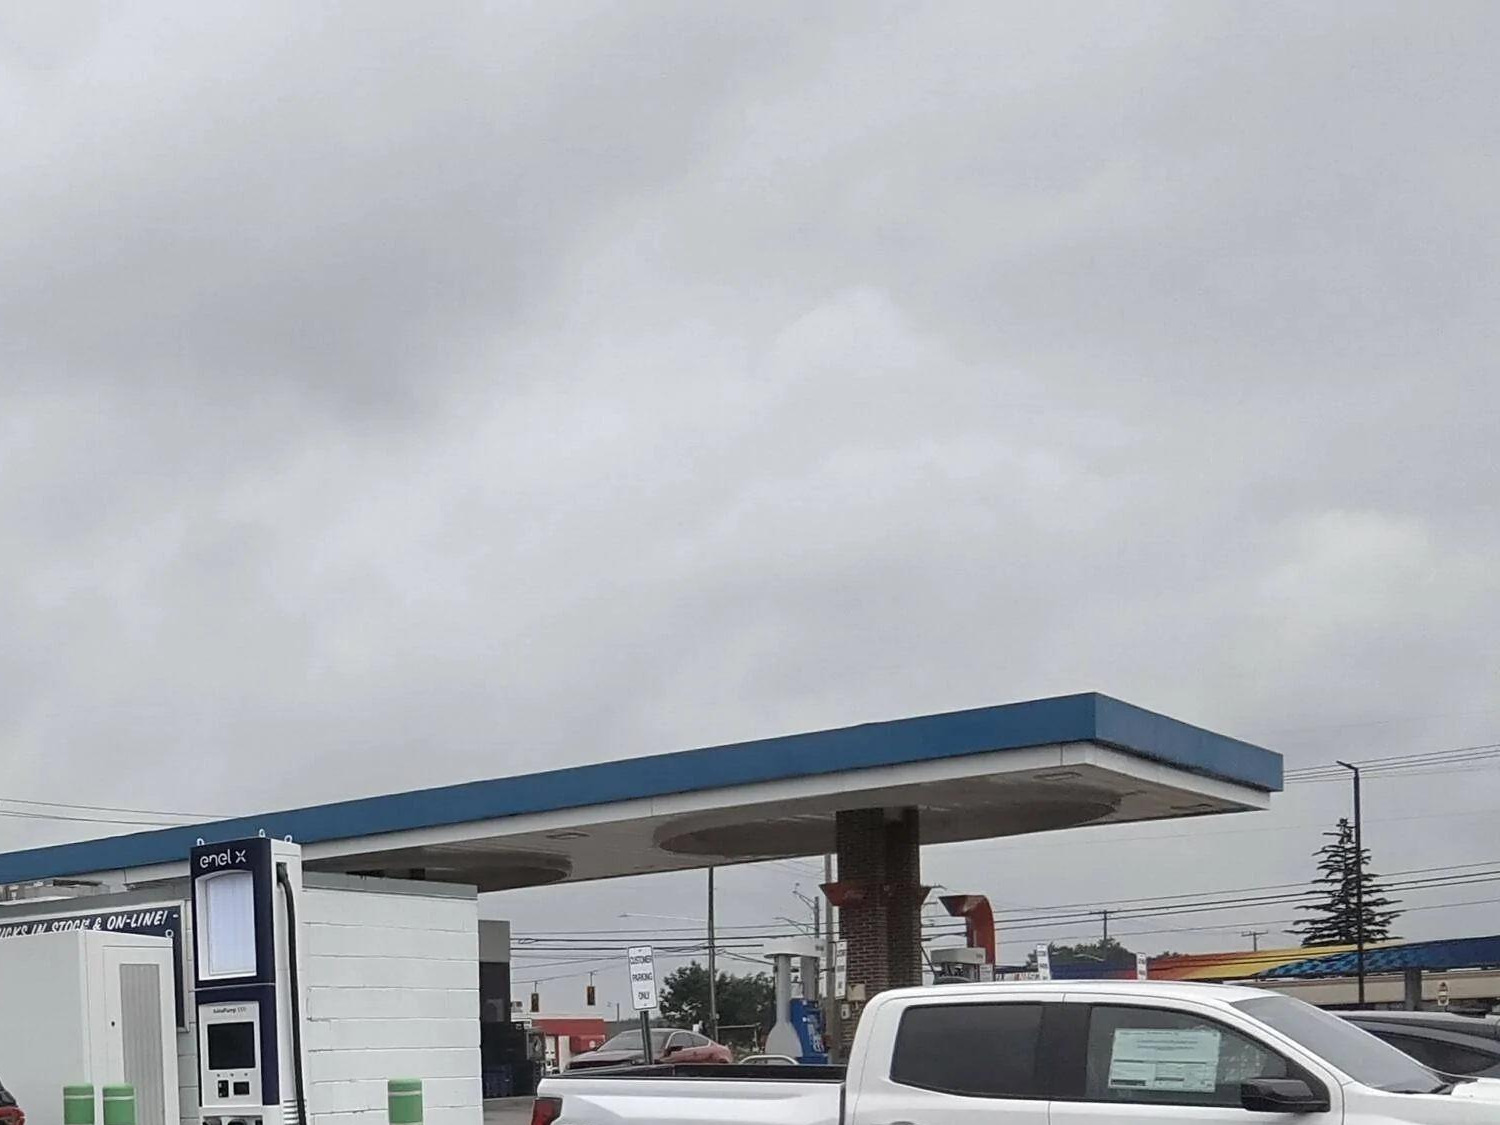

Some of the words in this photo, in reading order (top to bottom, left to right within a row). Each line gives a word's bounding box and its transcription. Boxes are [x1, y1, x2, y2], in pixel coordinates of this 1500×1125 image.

[199, 848, 232, 869] enel
[31, 922, 48, 936] IN
[51, 918, 90, 933] STOCK
[632, 972, 653, 981] PARKING
